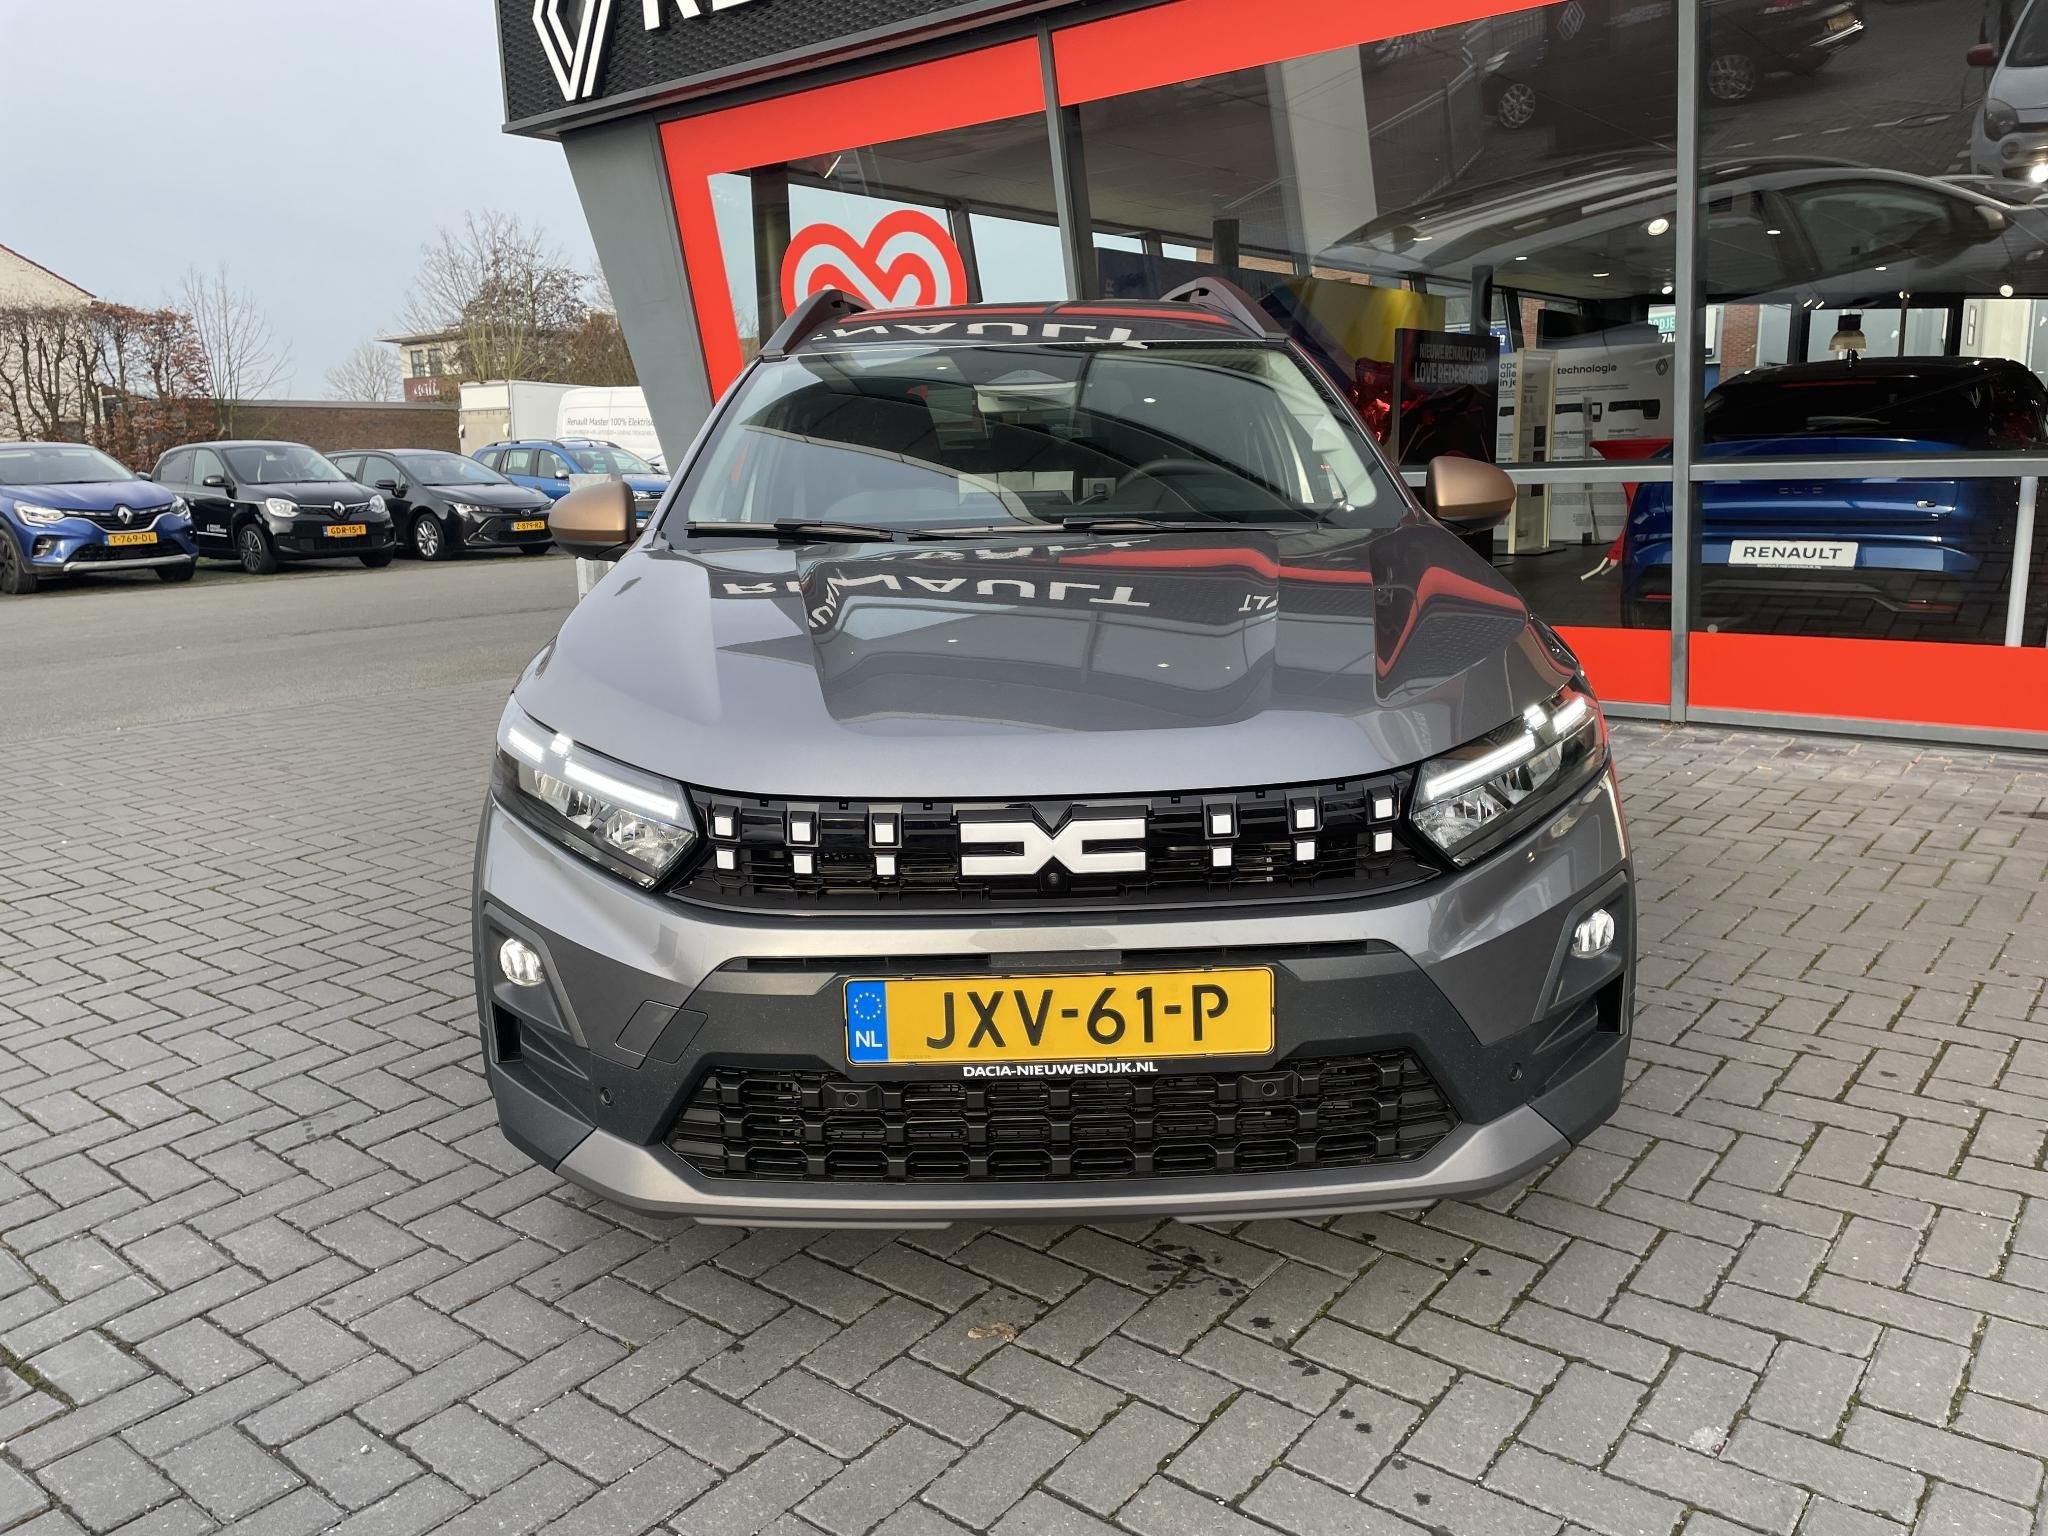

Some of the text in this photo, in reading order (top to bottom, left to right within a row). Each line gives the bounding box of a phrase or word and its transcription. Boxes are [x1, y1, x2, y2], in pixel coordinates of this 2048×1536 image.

[1414, 361, 1488, 384] LOVE REDESIGNED
[1557, 363, 1617, 375] technologie
[566, 417, 588, 427] Renault
[589, 417, 609, 427] Master
[611, 417, 627, 427] 100%
[1743, 546, 1842, 560] RENAULT
[926, 984, 1229, 1050] JXV-61-P
[855, 1030, 883, 1049] NL
[962, 1062, 1159, 1077] DACIA-NIEUWENDIJK.NL
